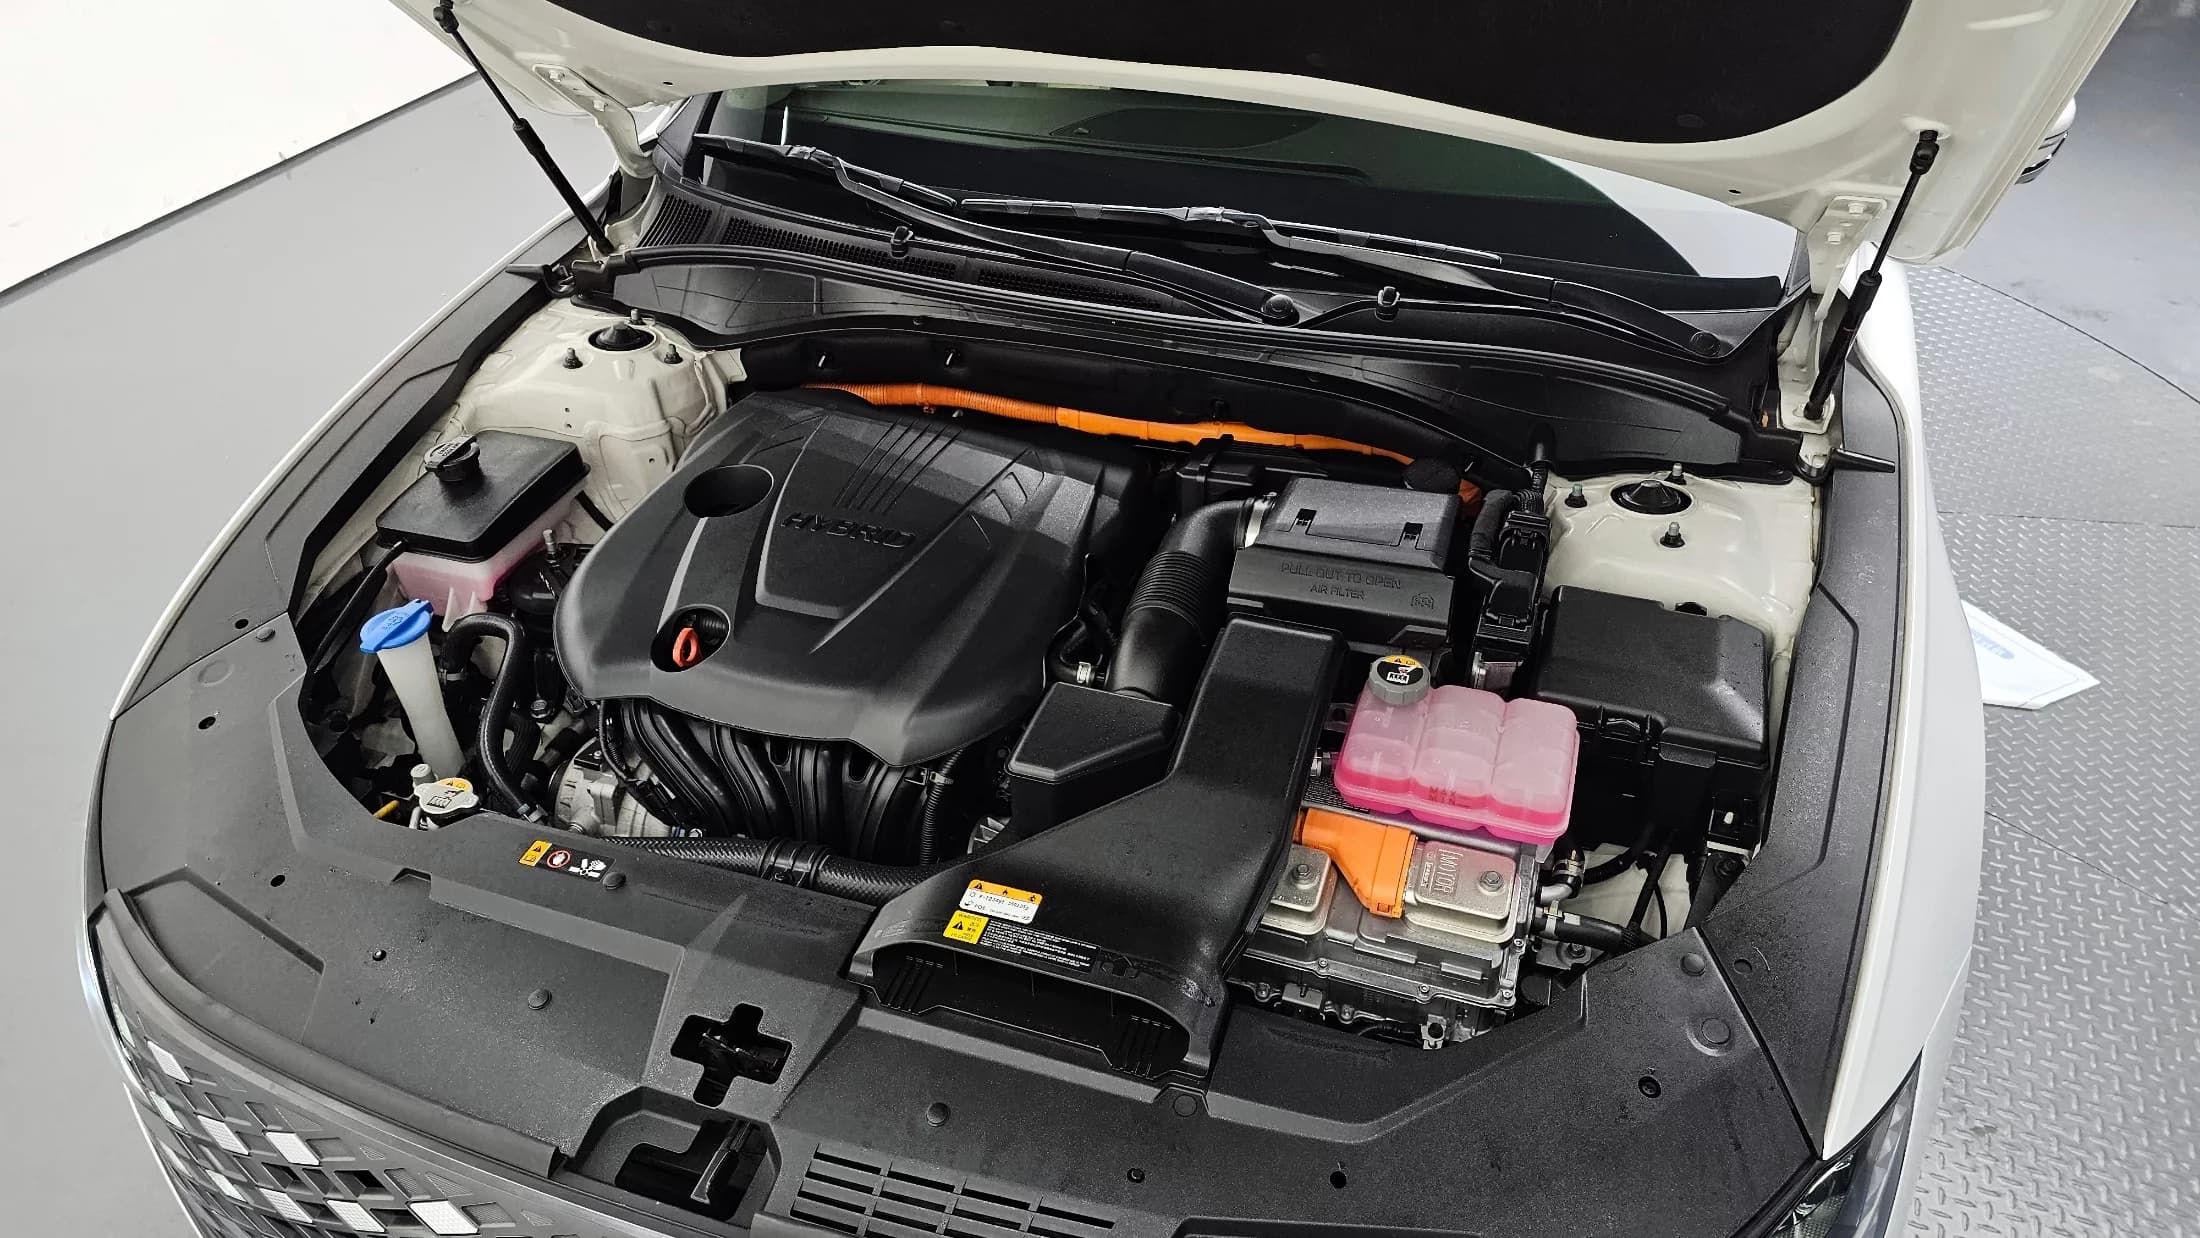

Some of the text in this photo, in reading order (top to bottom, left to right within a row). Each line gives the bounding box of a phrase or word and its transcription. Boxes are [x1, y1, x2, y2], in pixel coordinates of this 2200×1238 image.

[780, 513, 916, 548] HYBRID
[1280, 561, 1401, 589] PULL OUT TO OPEN
[1310, 584, 1365, 600] AIR FILTER
[1429, 786, 1456, 797] MAX
[1434, 852, 1459, 893] MOTOR
